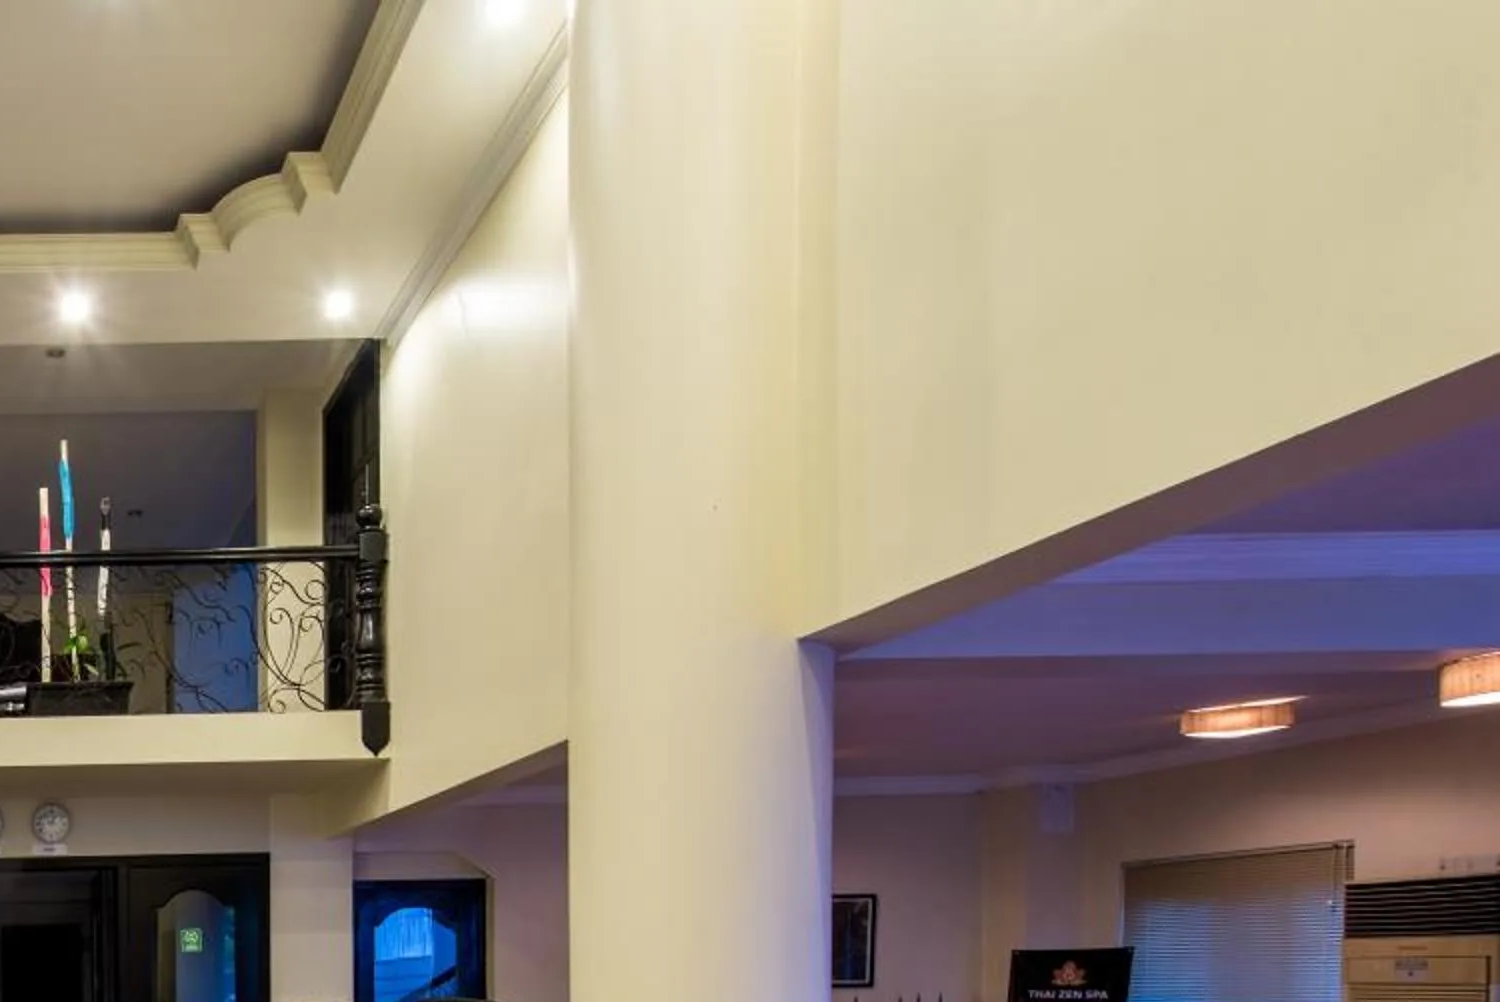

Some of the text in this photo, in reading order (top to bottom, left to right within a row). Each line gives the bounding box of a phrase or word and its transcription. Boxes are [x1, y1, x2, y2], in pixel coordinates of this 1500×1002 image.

[1027, 988, 1109, 1000] THAI ZEN SPA
